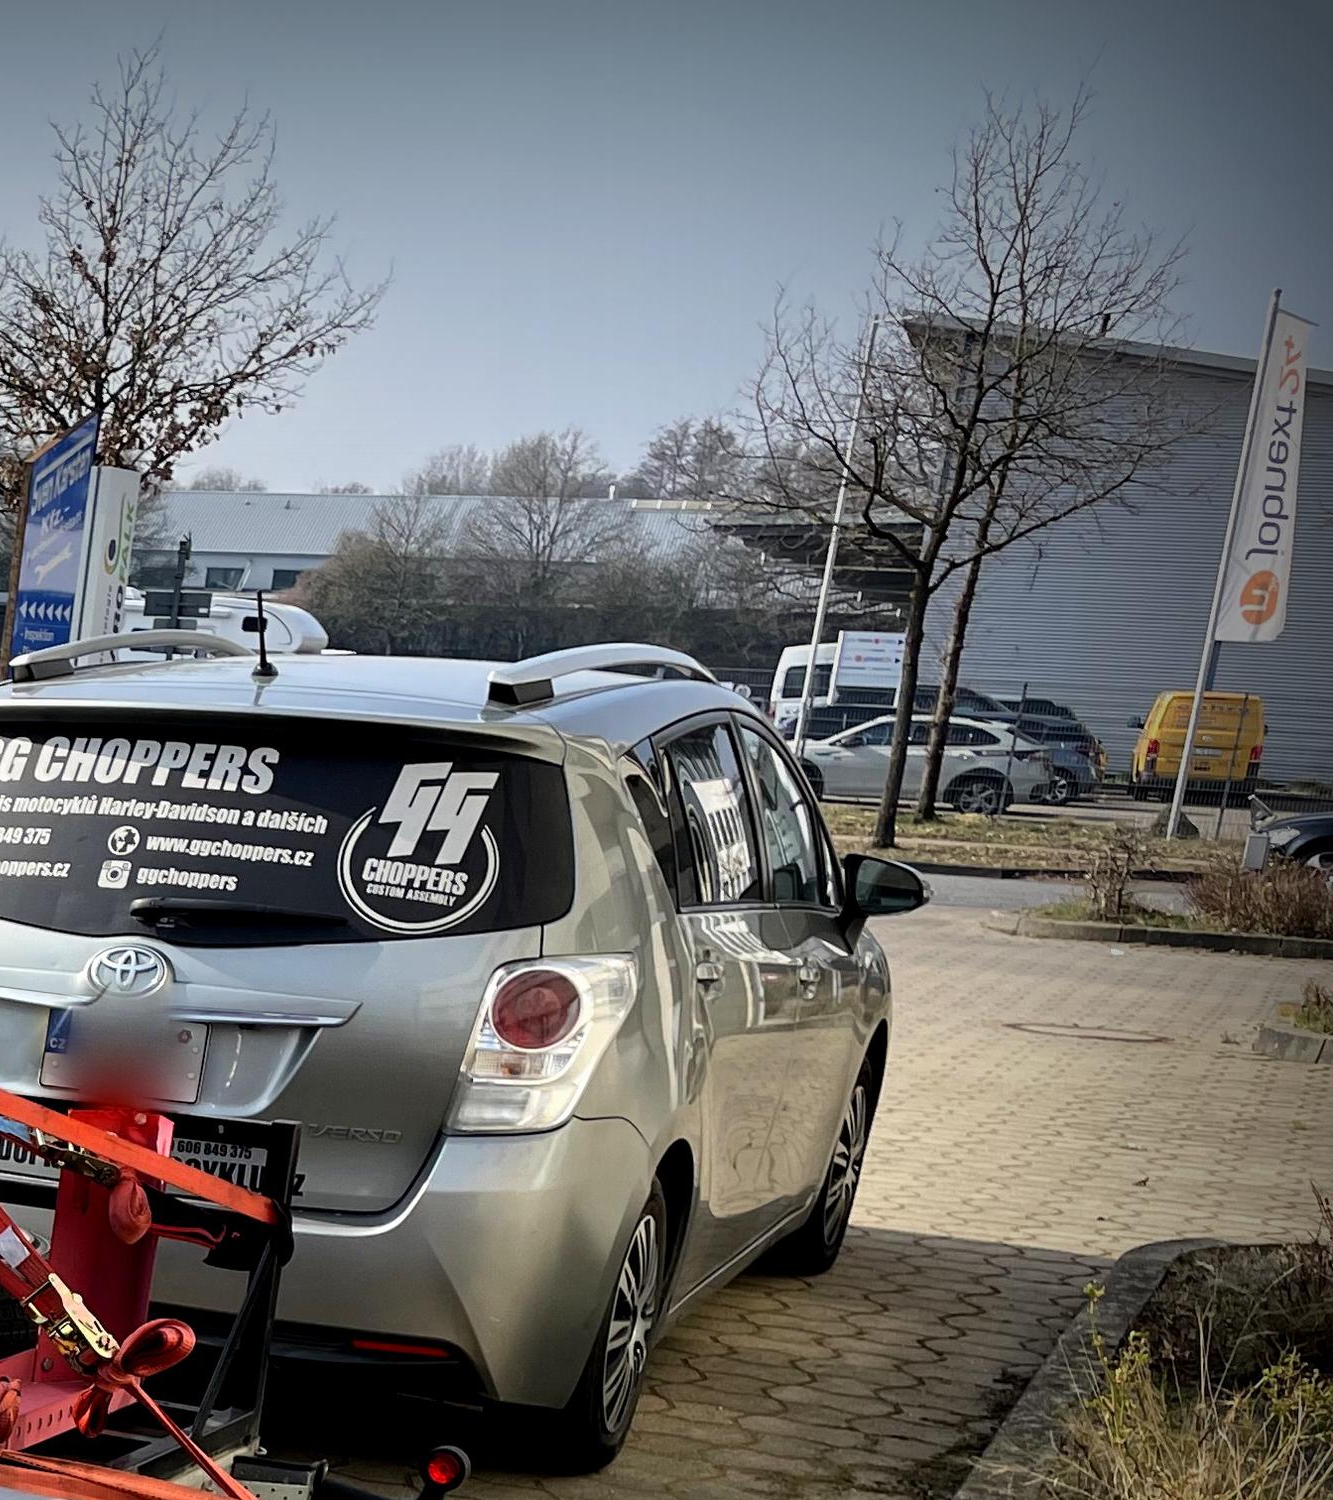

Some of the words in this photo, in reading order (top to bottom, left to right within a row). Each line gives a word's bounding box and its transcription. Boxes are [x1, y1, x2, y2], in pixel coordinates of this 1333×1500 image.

[34, 737, 280, 795] CHOPPERS
[13, 794, 98, 816] motocyklů
[98, 796, 241, 825] Harley-Davidson
[242, 810, 255, 827] a
[256, 808, 329, 835] dalších
[24, 828, 51, 846] 375
[146, 836, 315, 867] www.ggchoppers.cz
[136, 866, 238, 891] ggchoppers
[362, 858, 469, 895] CHOPPERS
[366, 883, 405, 899] CUSTOM
[406, 889, 457, 907] ASSEMBLY
[49, 1037, 66, 1050] CZ
[308, 1123, 403, 1143] VERSO
[177, 1140, 201, 1155] 606
[204, 1143, 228, 1157] 849
[230, 1146, 252, 1159] 375
